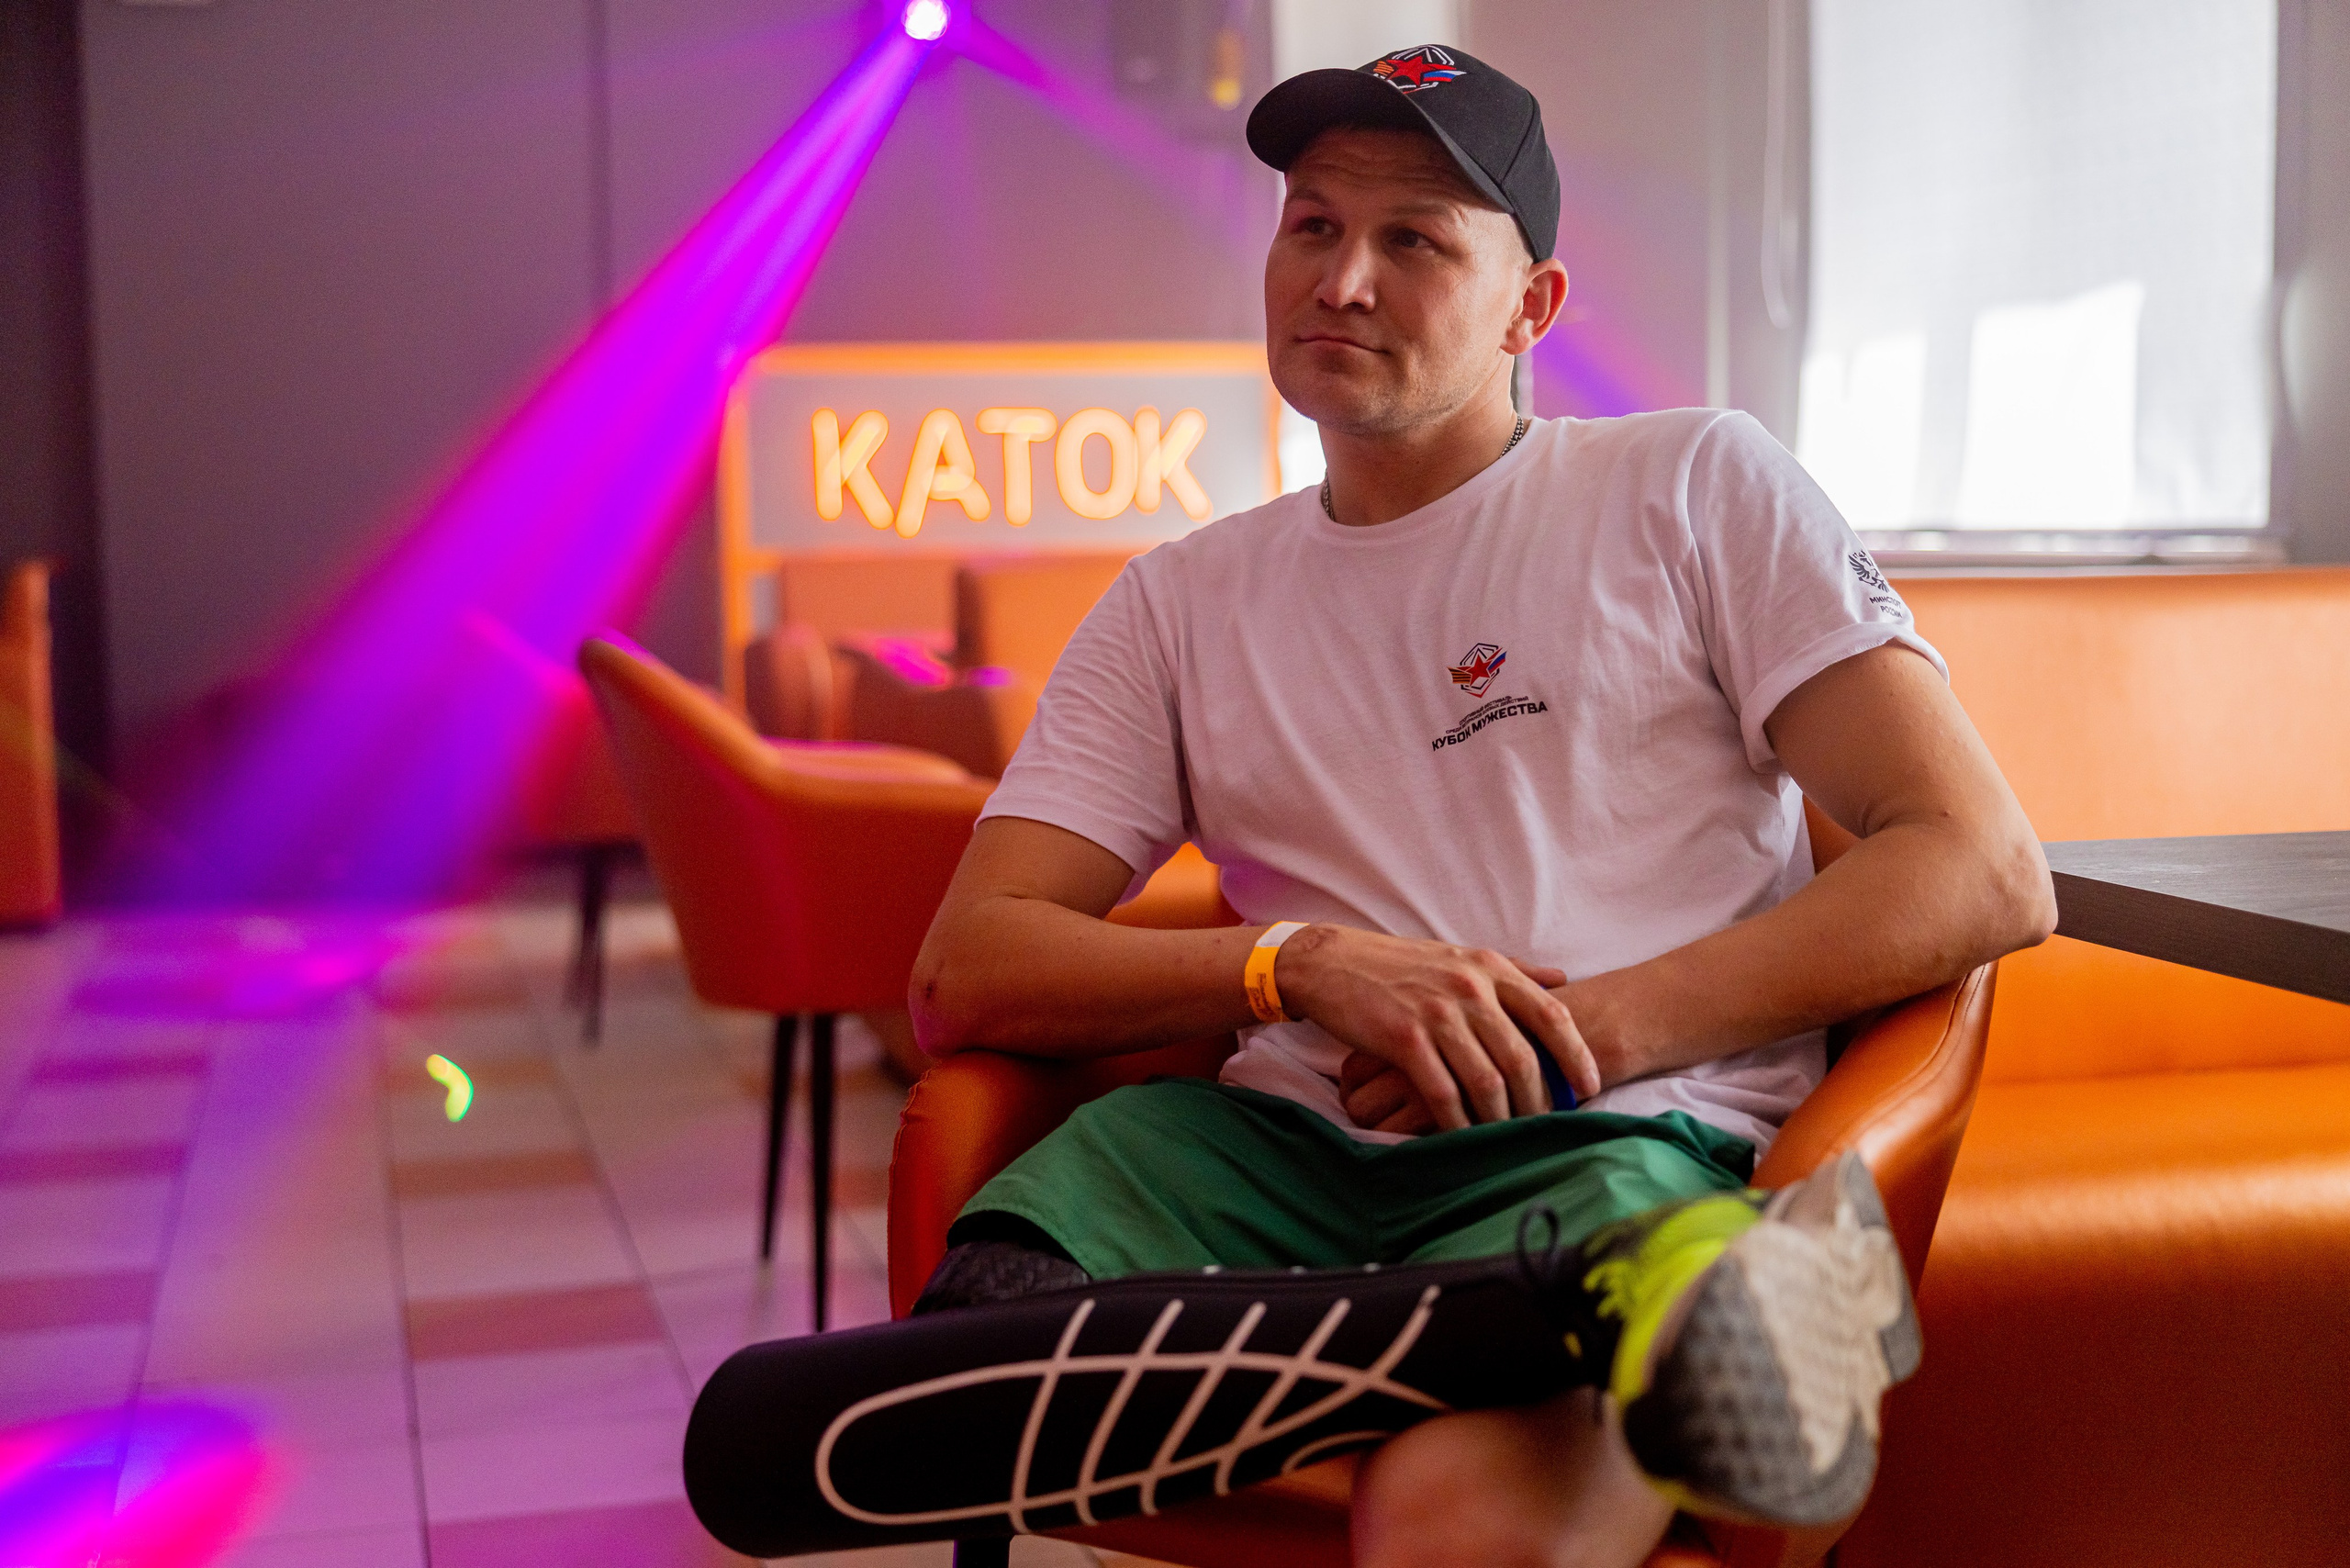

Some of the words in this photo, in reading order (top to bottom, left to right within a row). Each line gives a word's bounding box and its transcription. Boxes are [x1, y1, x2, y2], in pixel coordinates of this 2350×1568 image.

[811, 406, 1213, 539] КАТОК
[1431, 726, 1472, 752] КУБОК
[1472, 700, 1548, 734] МУЖЕСТВА
